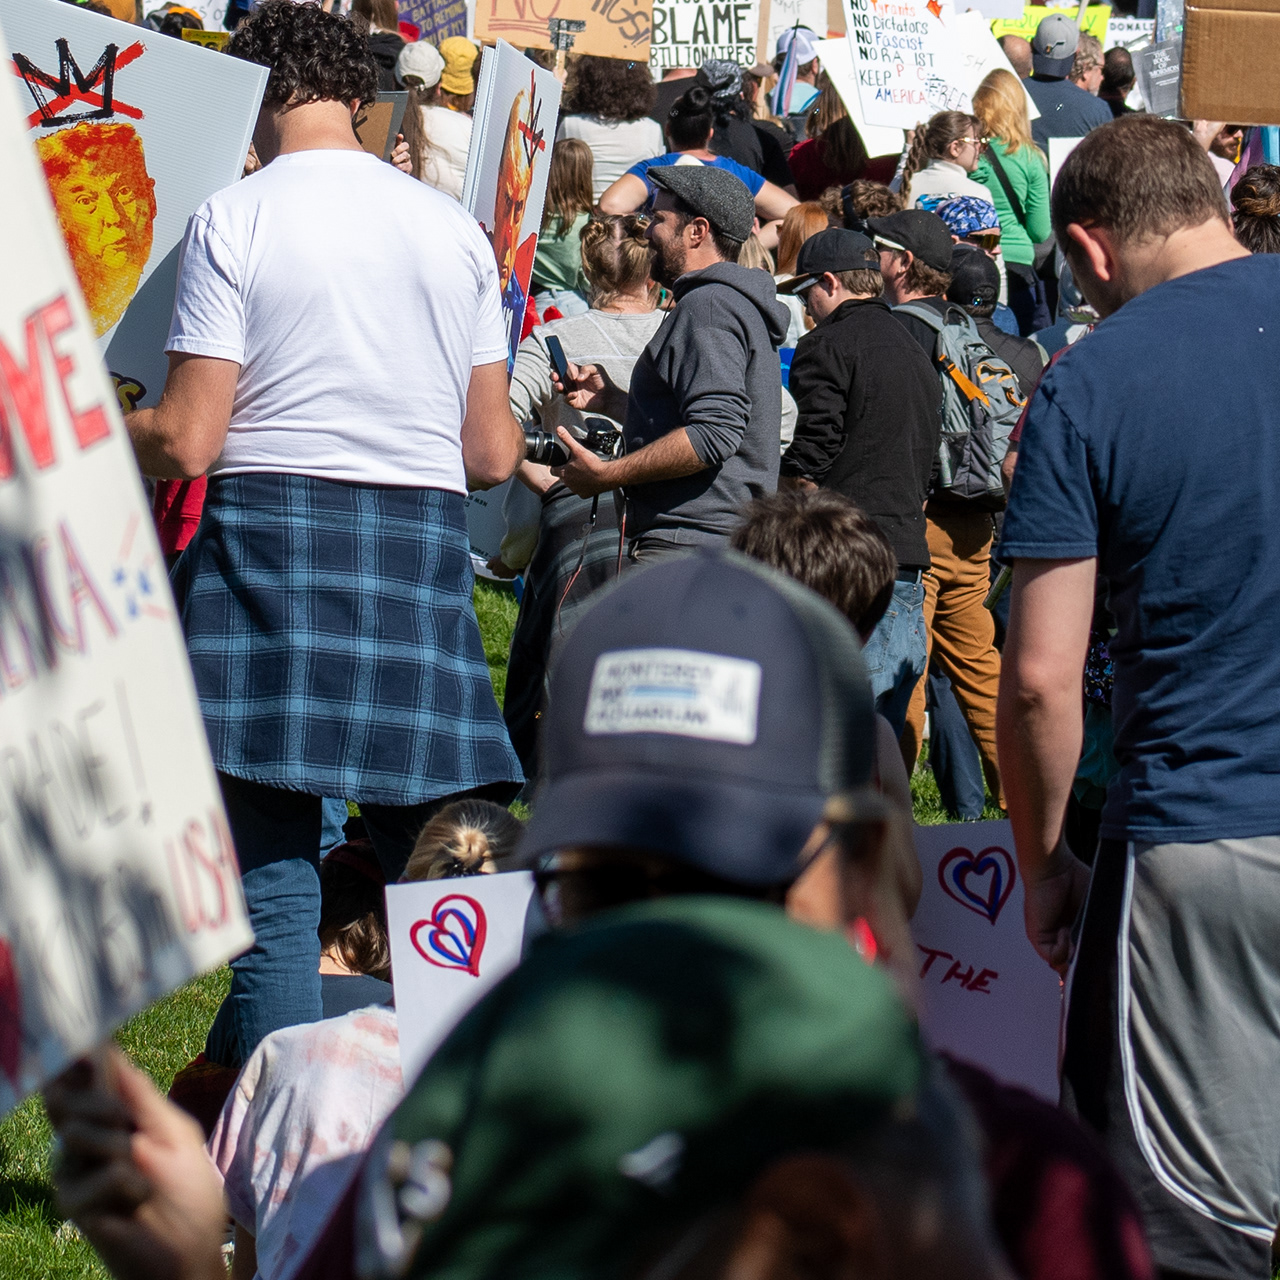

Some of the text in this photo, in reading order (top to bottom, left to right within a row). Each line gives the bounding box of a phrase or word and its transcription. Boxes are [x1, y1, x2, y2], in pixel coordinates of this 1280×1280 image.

[650, 4, 754, 46] BLAME
[853, 13, 929, 36] NO Dictators
[856, 29, 924, 51] NO Fascist
[859, 46, 878, 61] NO
[1153, 55, 1172, 65] BOOK
[1149, 64, 1180, 79] MORMON
[1158, 62, 1167, 70] OF
[858, 70, 892, 87] KEEP
[875, 87, 928, 106] AMERICA
[916, 944, 999, 995] THE
